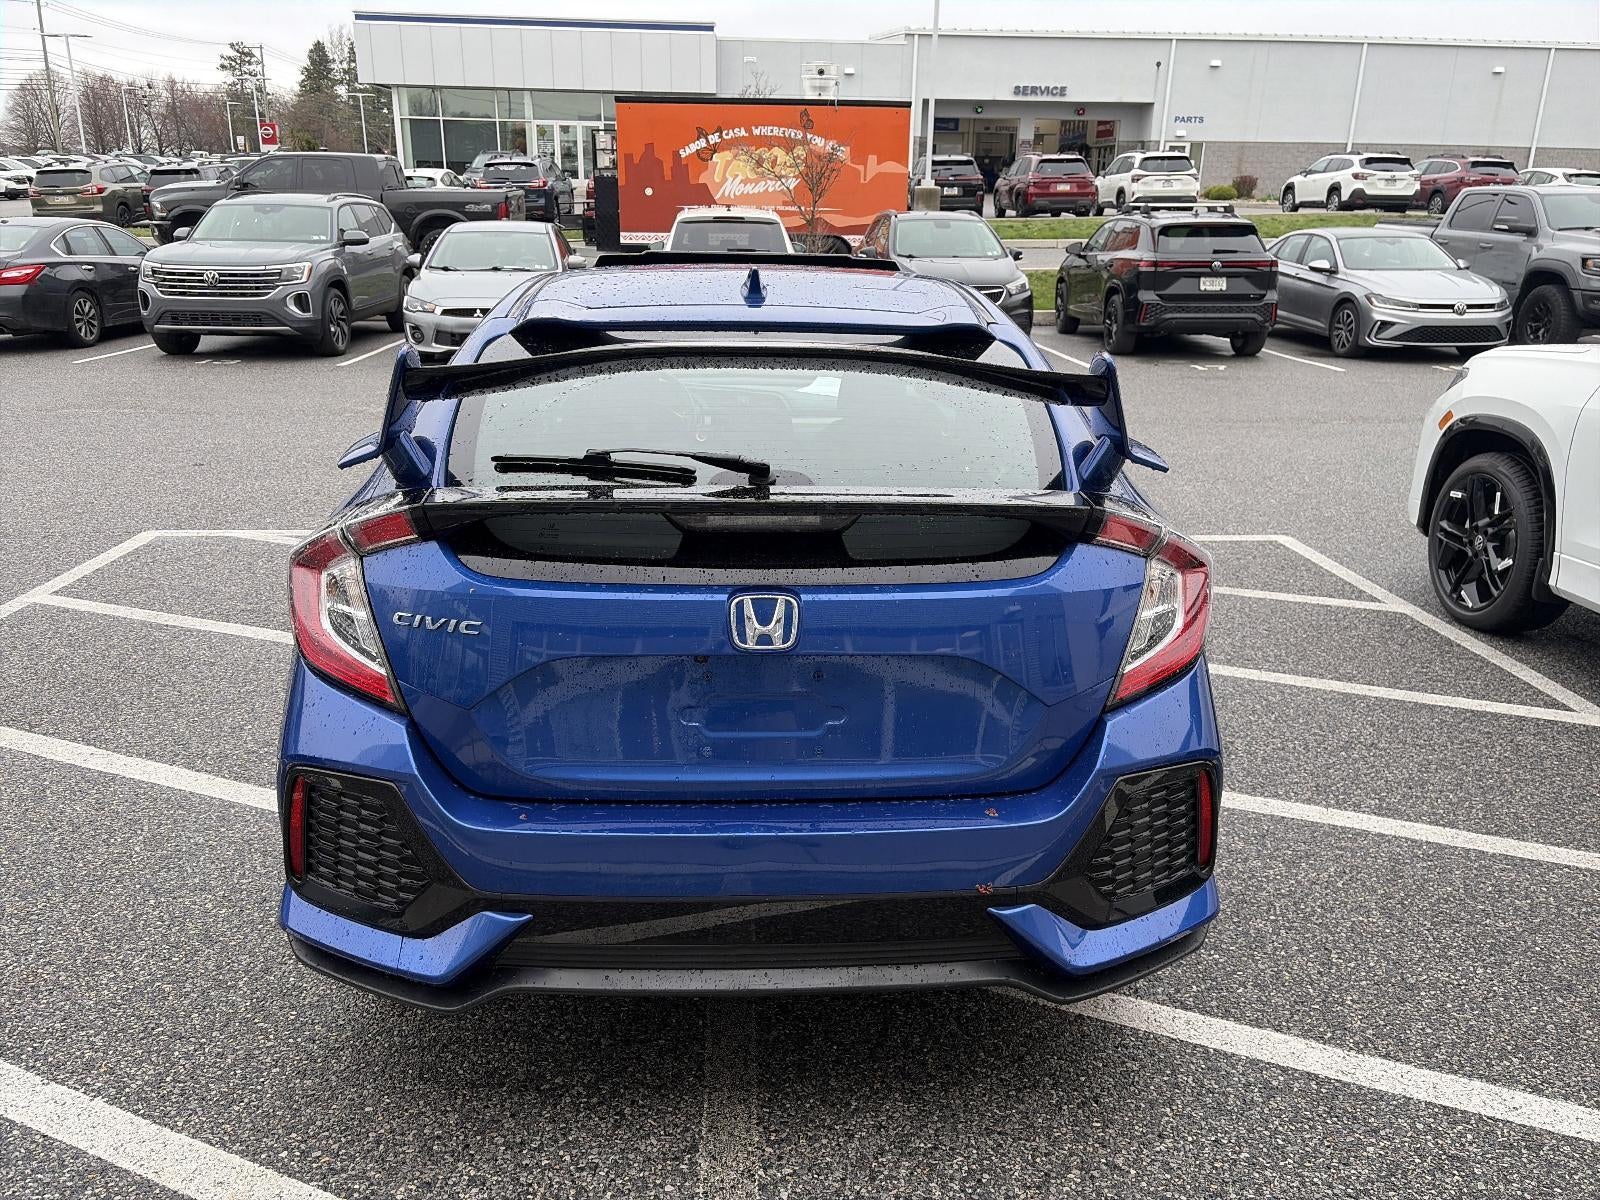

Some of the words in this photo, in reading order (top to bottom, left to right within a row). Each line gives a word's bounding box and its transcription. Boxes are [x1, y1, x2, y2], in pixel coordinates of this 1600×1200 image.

[1013, 85, 1068, 97] SERVICE
[1174, 115, 1205, 124] PARTS
[679, 138, 707, 158] SABOR
[707, 132, 721, 145] DE
[751, 125, 803, 140] WHEREVER
[806, 132, 825, 147] YOU
[392, 611, 483, 635] CIVIC
